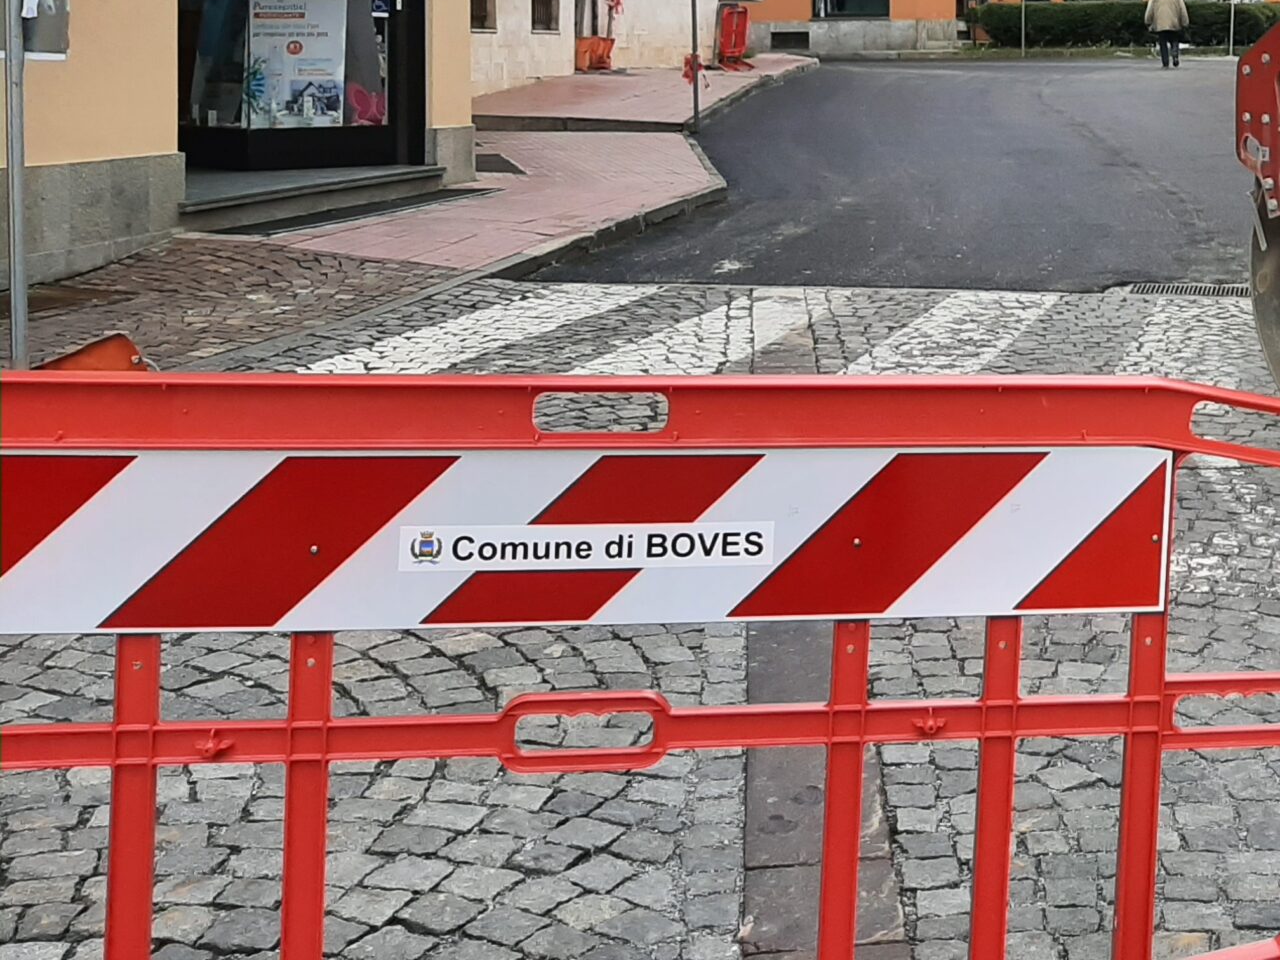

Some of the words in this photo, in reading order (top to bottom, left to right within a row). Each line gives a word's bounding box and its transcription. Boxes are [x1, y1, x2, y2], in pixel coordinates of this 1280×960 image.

[452, 535, 593, 561] Comune
[605, 534, 634, 559] di
[646, 531, 764, 558] BOVES
